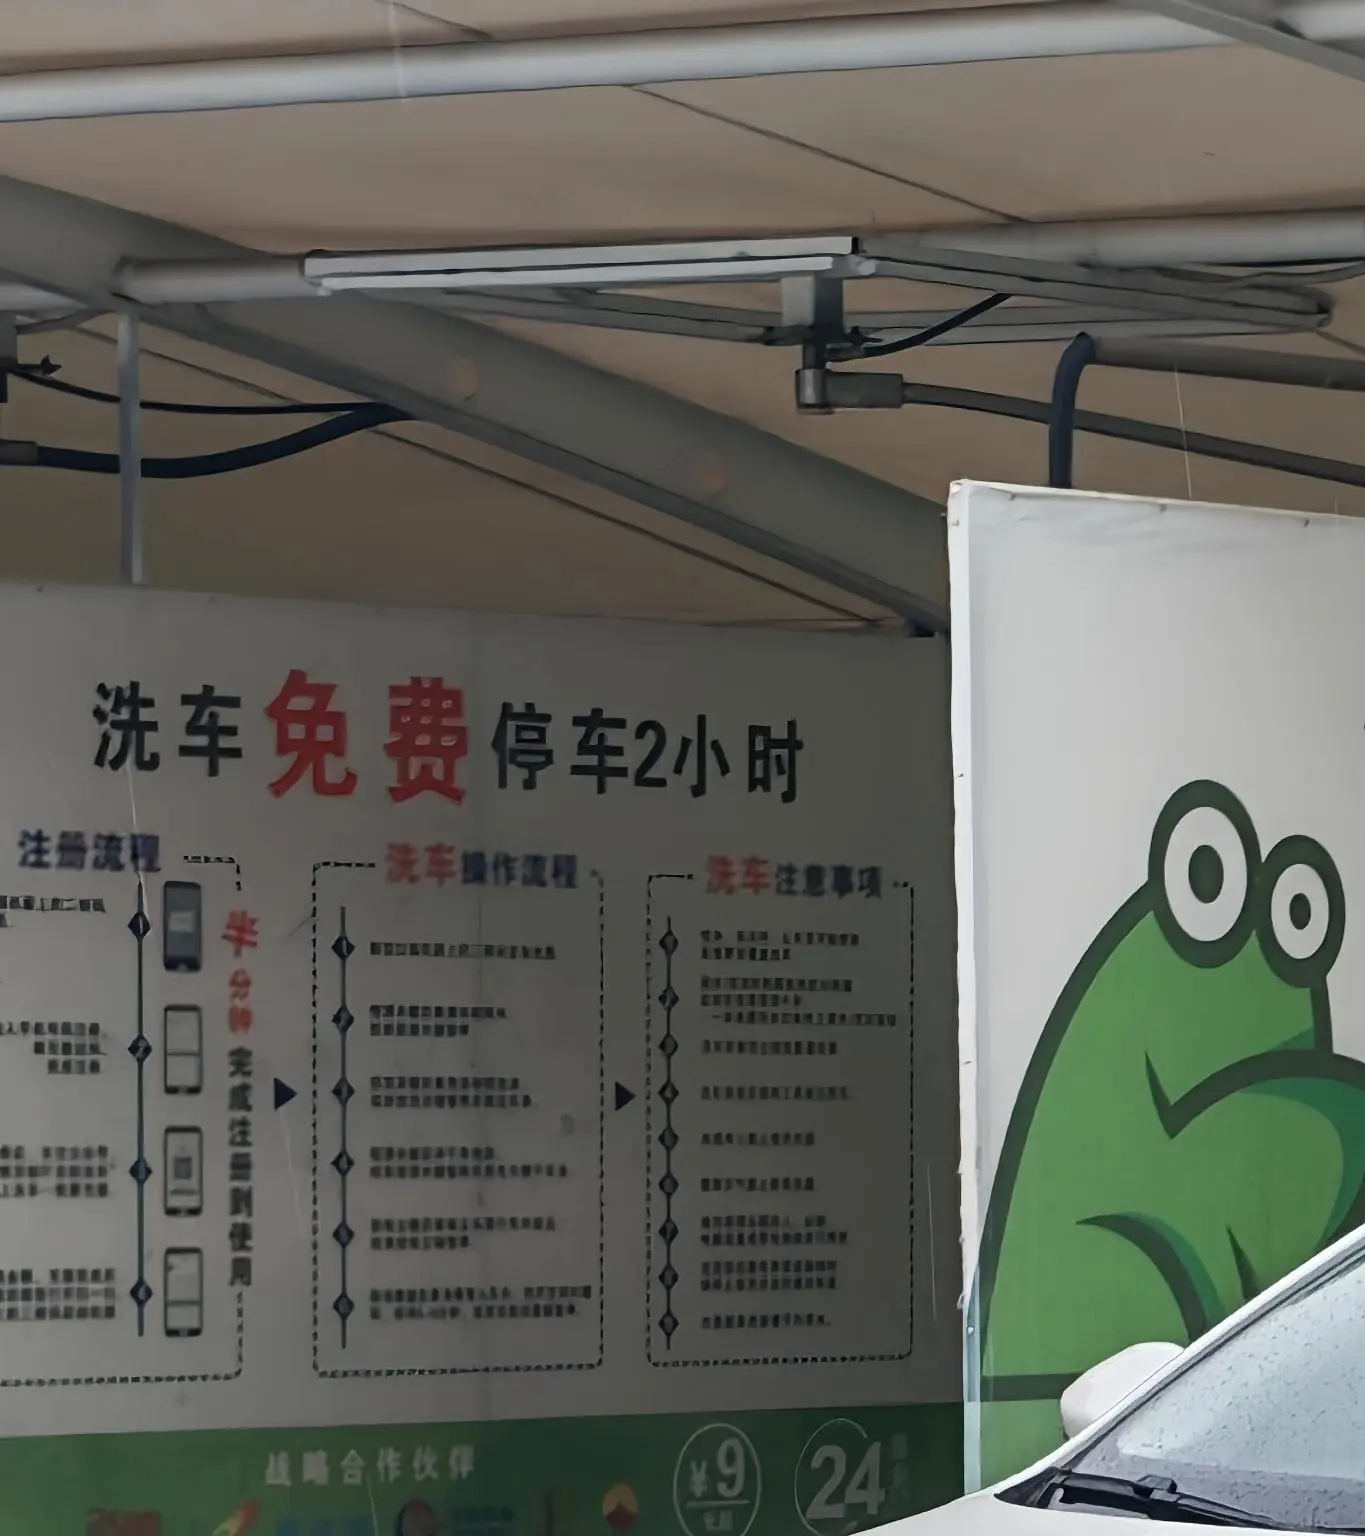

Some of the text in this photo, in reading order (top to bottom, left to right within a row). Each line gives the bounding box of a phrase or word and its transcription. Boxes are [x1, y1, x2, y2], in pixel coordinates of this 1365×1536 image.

[92, 669, 804, 806] 洗车免费停车2小时
